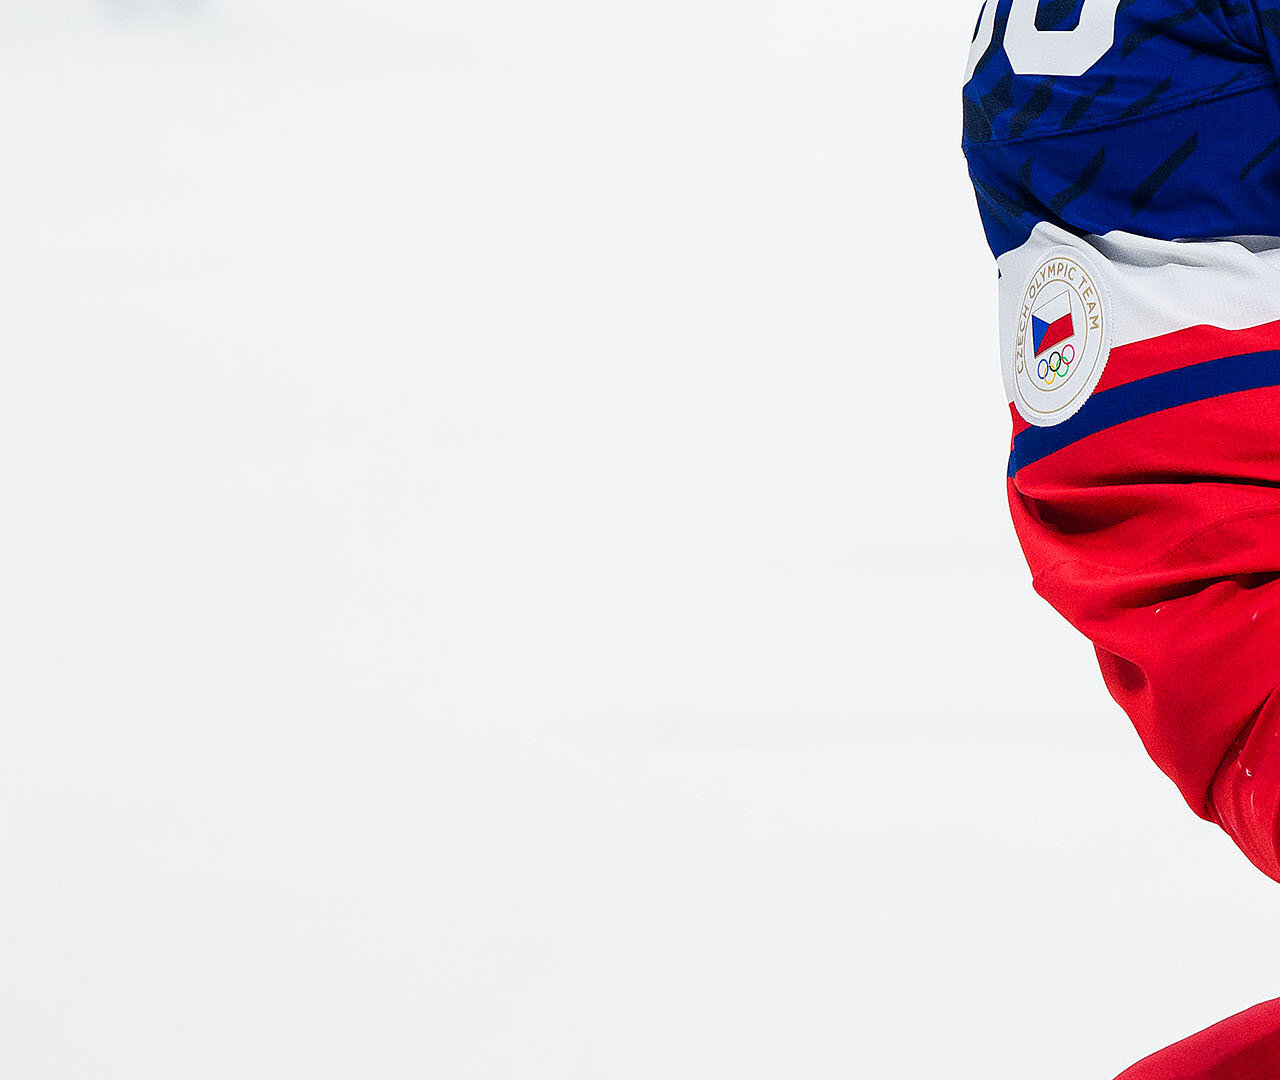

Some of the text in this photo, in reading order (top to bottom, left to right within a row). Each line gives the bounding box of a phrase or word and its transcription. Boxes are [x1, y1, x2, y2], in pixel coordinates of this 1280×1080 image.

[1017, 262, 1099, 374] CZECH OLYMPIC TEAM
